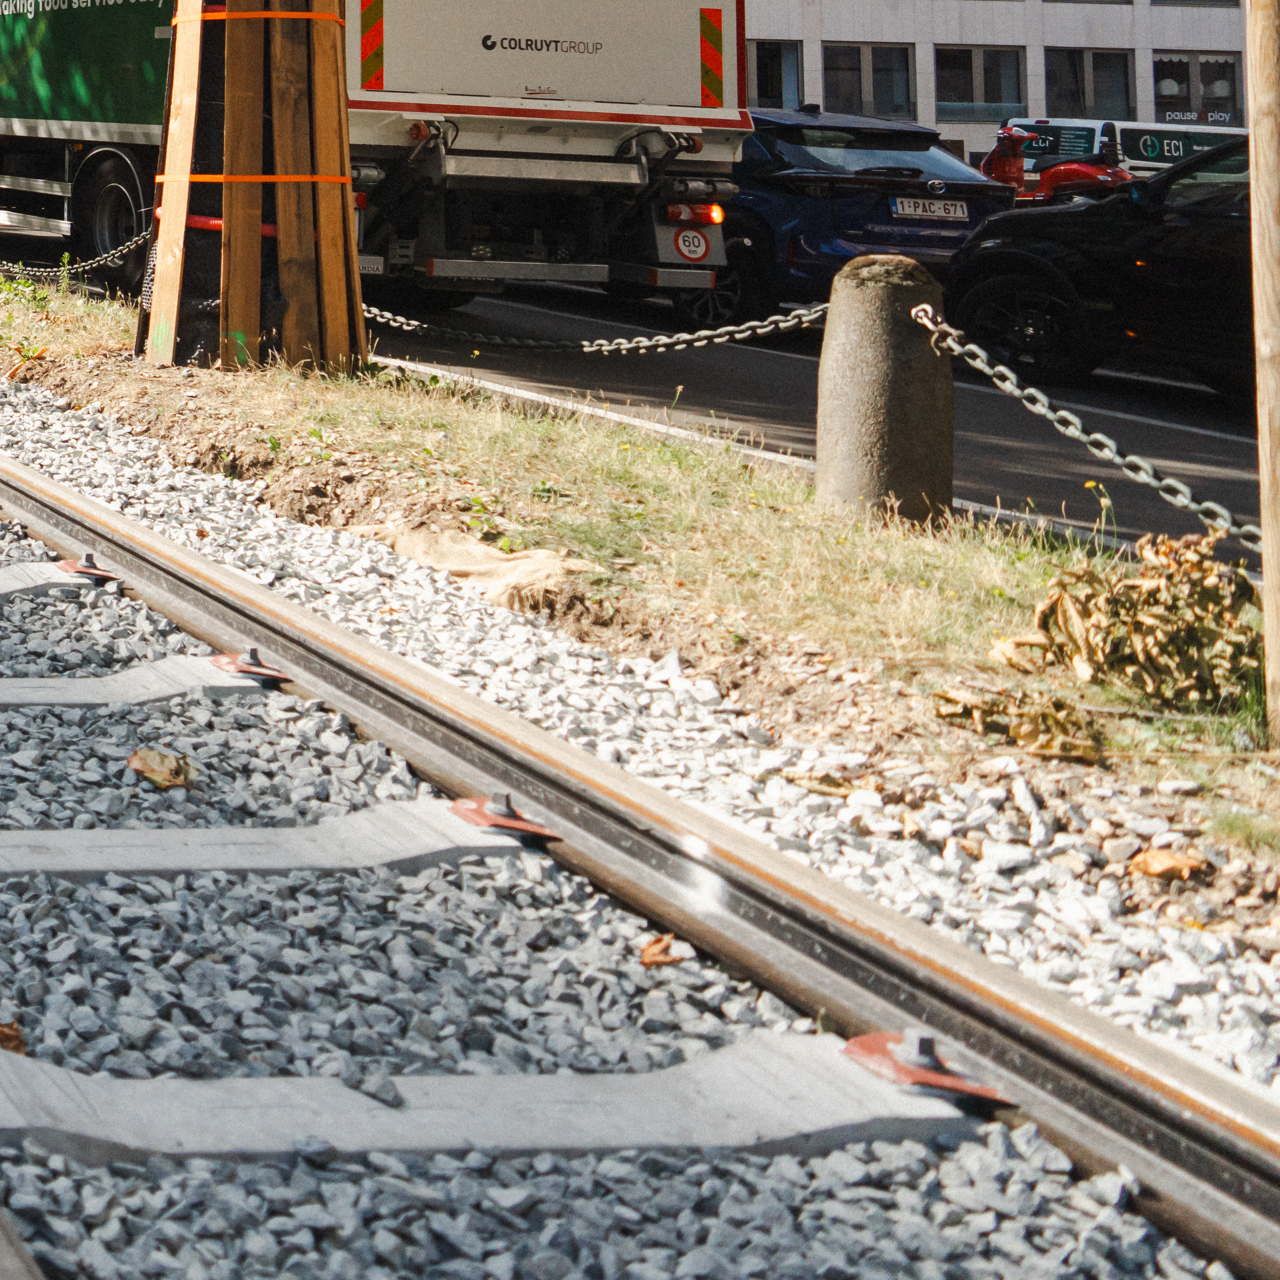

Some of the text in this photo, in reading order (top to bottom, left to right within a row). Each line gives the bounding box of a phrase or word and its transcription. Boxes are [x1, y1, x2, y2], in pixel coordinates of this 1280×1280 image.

[1166, 110, 1231, 122] pause play
[1163, 140, 1183, 156] ECI
[682, 235, 701, 248] 60
